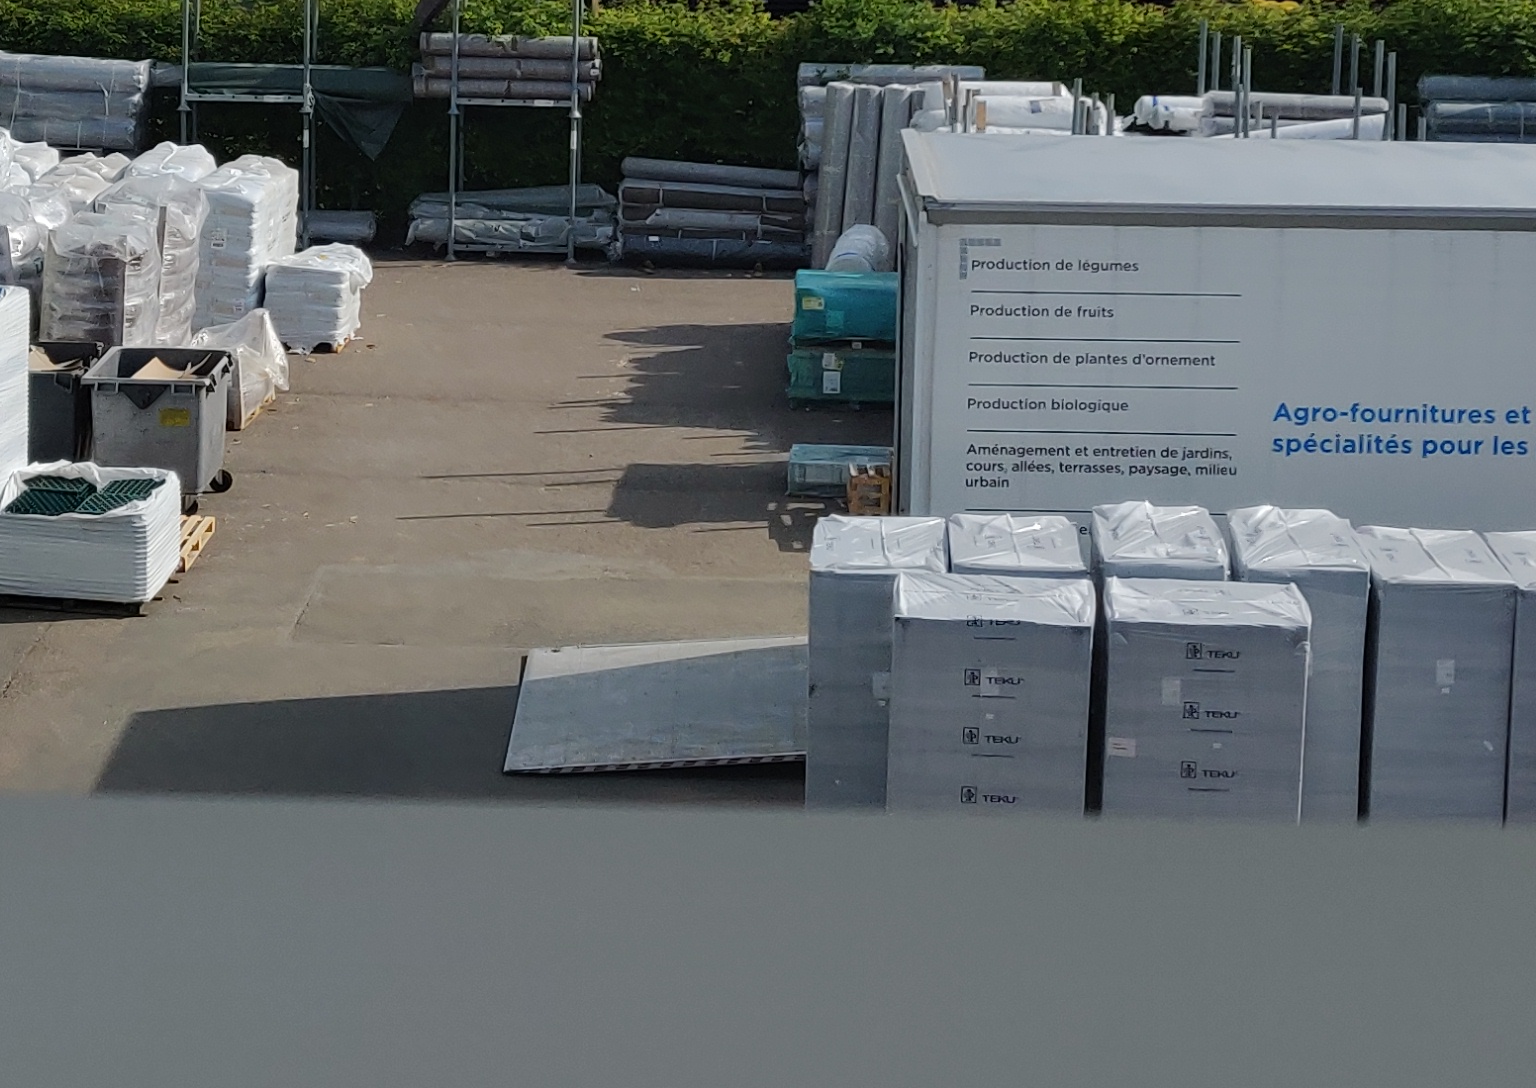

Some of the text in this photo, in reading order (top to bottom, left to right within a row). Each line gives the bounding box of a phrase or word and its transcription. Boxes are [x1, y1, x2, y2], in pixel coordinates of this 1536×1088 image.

[971, 259, 1139, 274] Production de légumes
[970, 304, 1114, 318] Production de fruits
[968, 351, 1216, 367] Production de plantes d'ornement
[967, 398, 1129, 414] Production biologique
[1272, 402, 1532, 427] Agro-fournitures et
[966, 444, 1233, 461] Aménagement et entretien de jardins,
[1271, 432, 1413, 457] spécialités
[1421, 437, 1484, 459] pour
[1492, 435, 1529, 456] les
[966, 462, 1008, 474] cours,
[1059, 462, 1125, 476] terrasses,
[1195, 463, 1237, 477] milieu
[965, 476, 1010, 489] urbain
